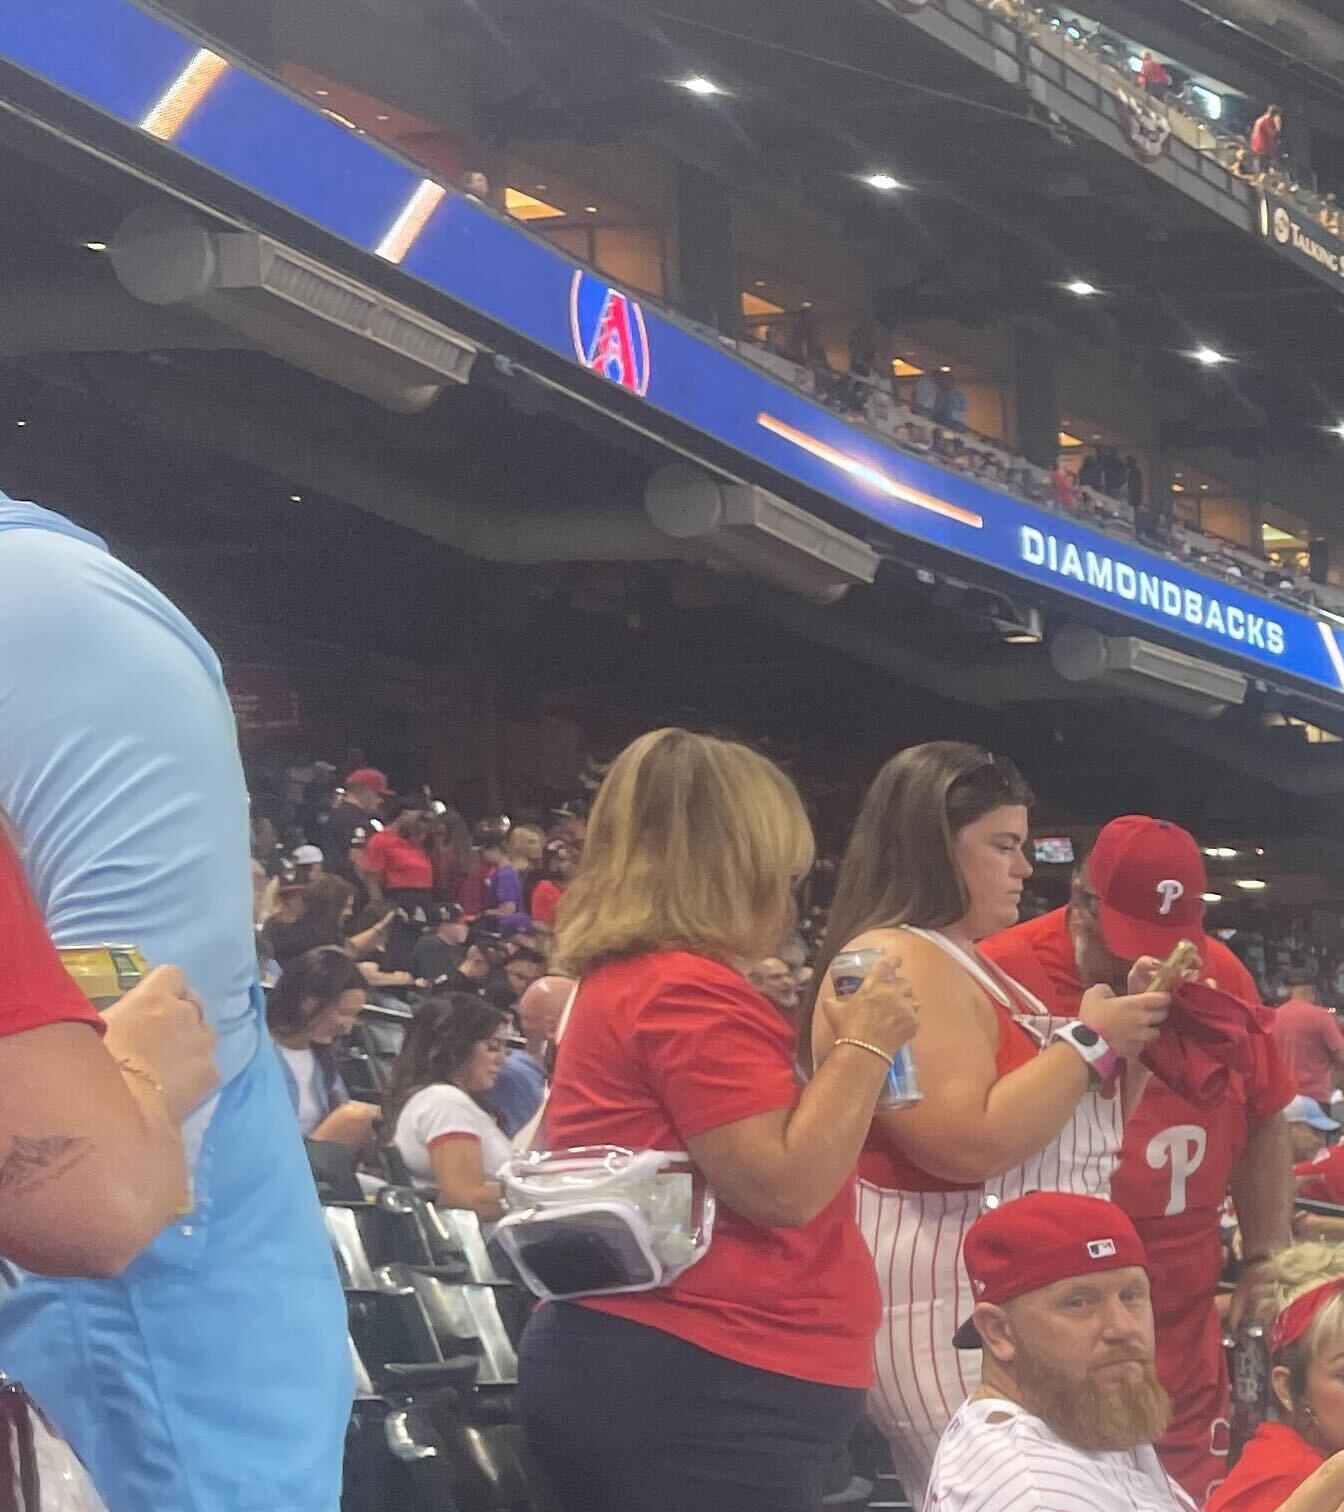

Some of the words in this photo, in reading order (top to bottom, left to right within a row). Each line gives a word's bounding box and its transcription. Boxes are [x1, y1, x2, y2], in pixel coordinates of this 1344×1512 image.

[1020, 525, 1286, 655] DIAMONDBACKS
[1157, 879, 1184, 915] P
[1145, 1123, 1207, 1217] P
